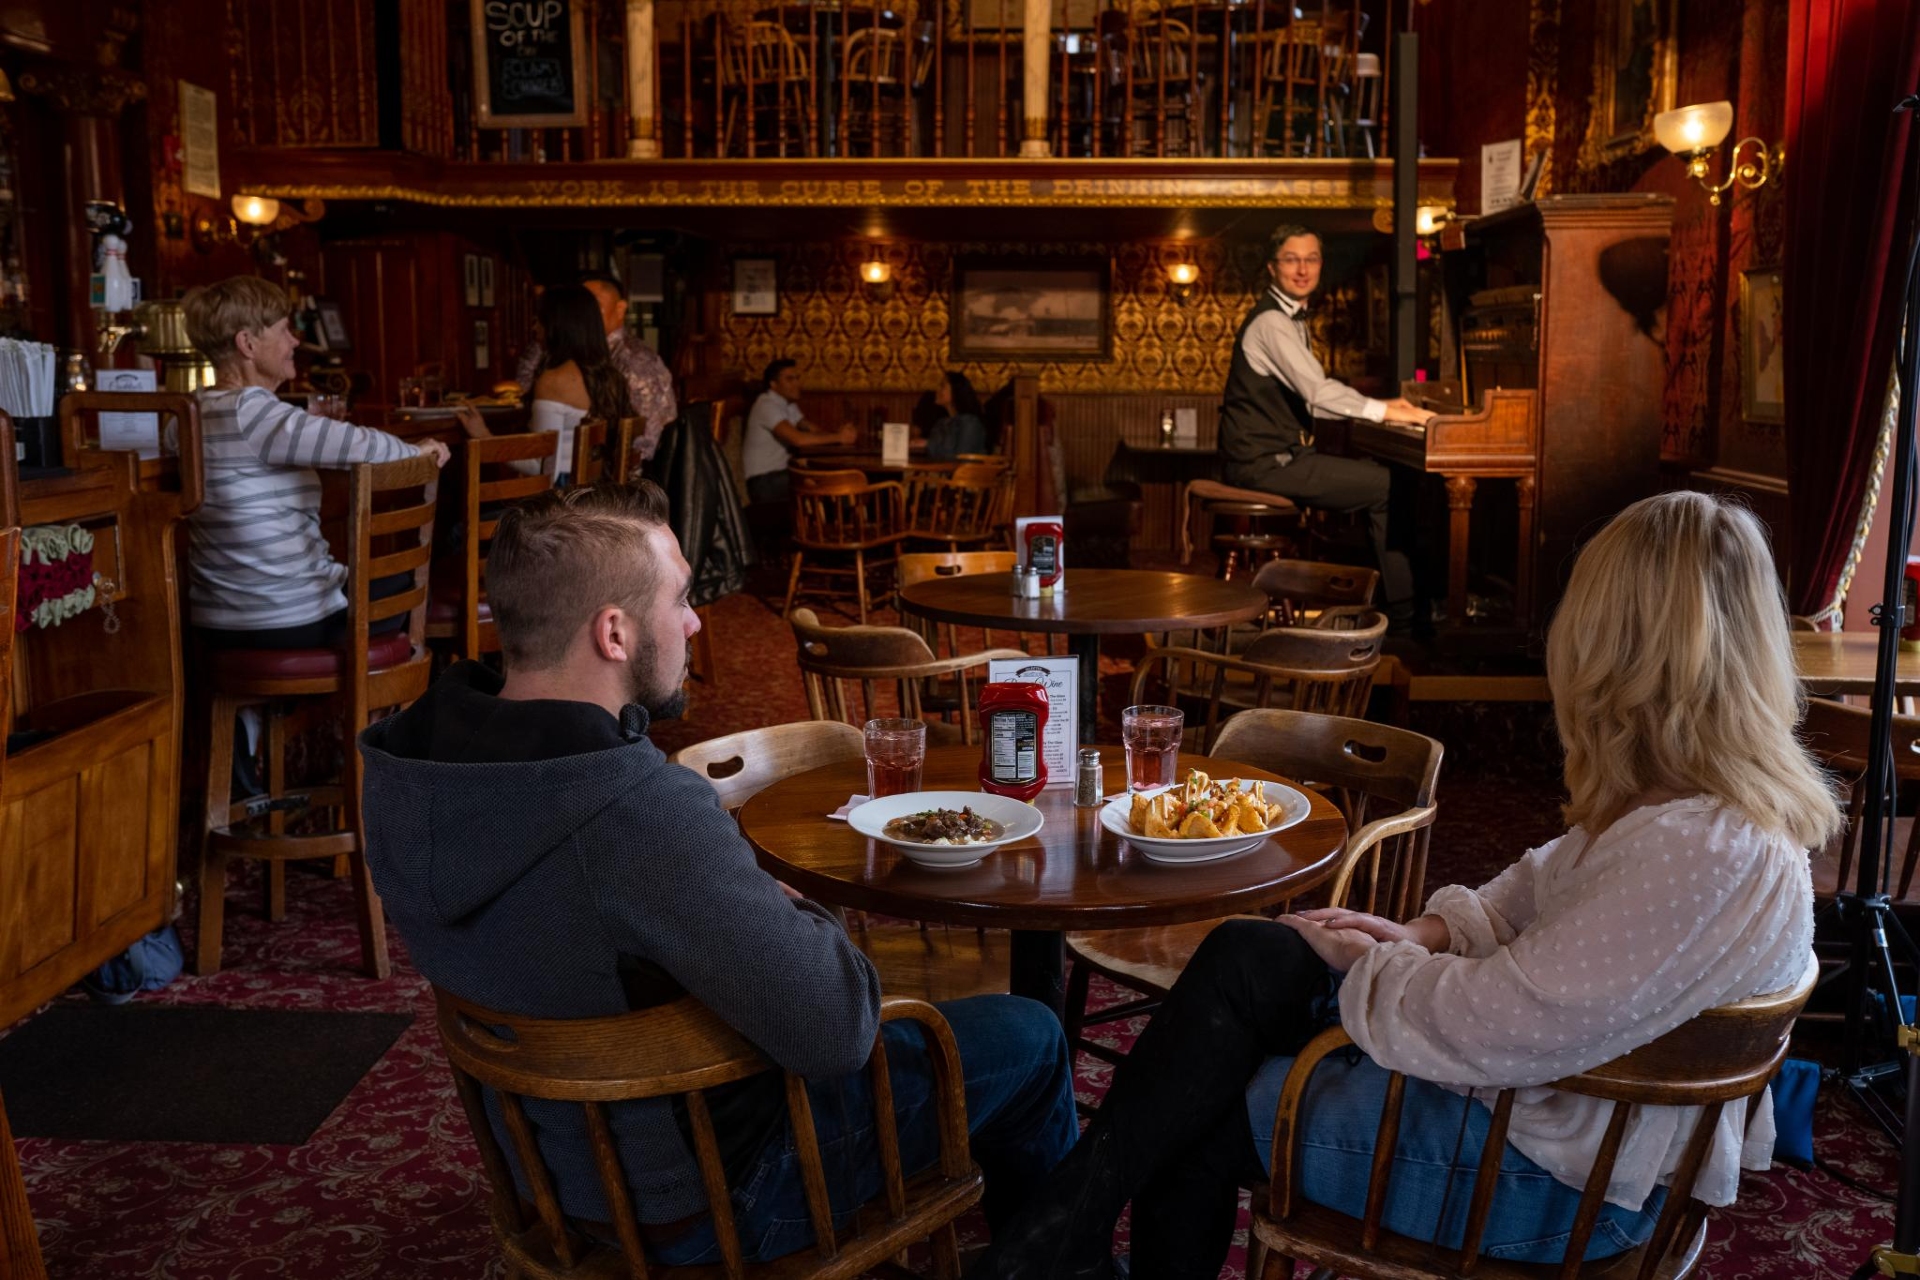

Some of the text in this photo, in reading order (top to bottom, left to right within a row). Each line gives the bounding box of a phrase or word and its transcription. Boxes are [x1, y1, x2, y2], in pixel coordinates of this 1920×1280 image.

[485, 1, 562, 30] SOUP
[500, 29, 527, 47] OF
[527, 180, 623, 195] WORK
[648, 180, 680, 195] IS
[700, 180, 760, 195] THE
[780, 180, 881, 195] CURSE
[904, 180, 944, 195] OF
[967, 179, 1031, 195] THE
[1229, 179, 1374, 196] CLASSES
